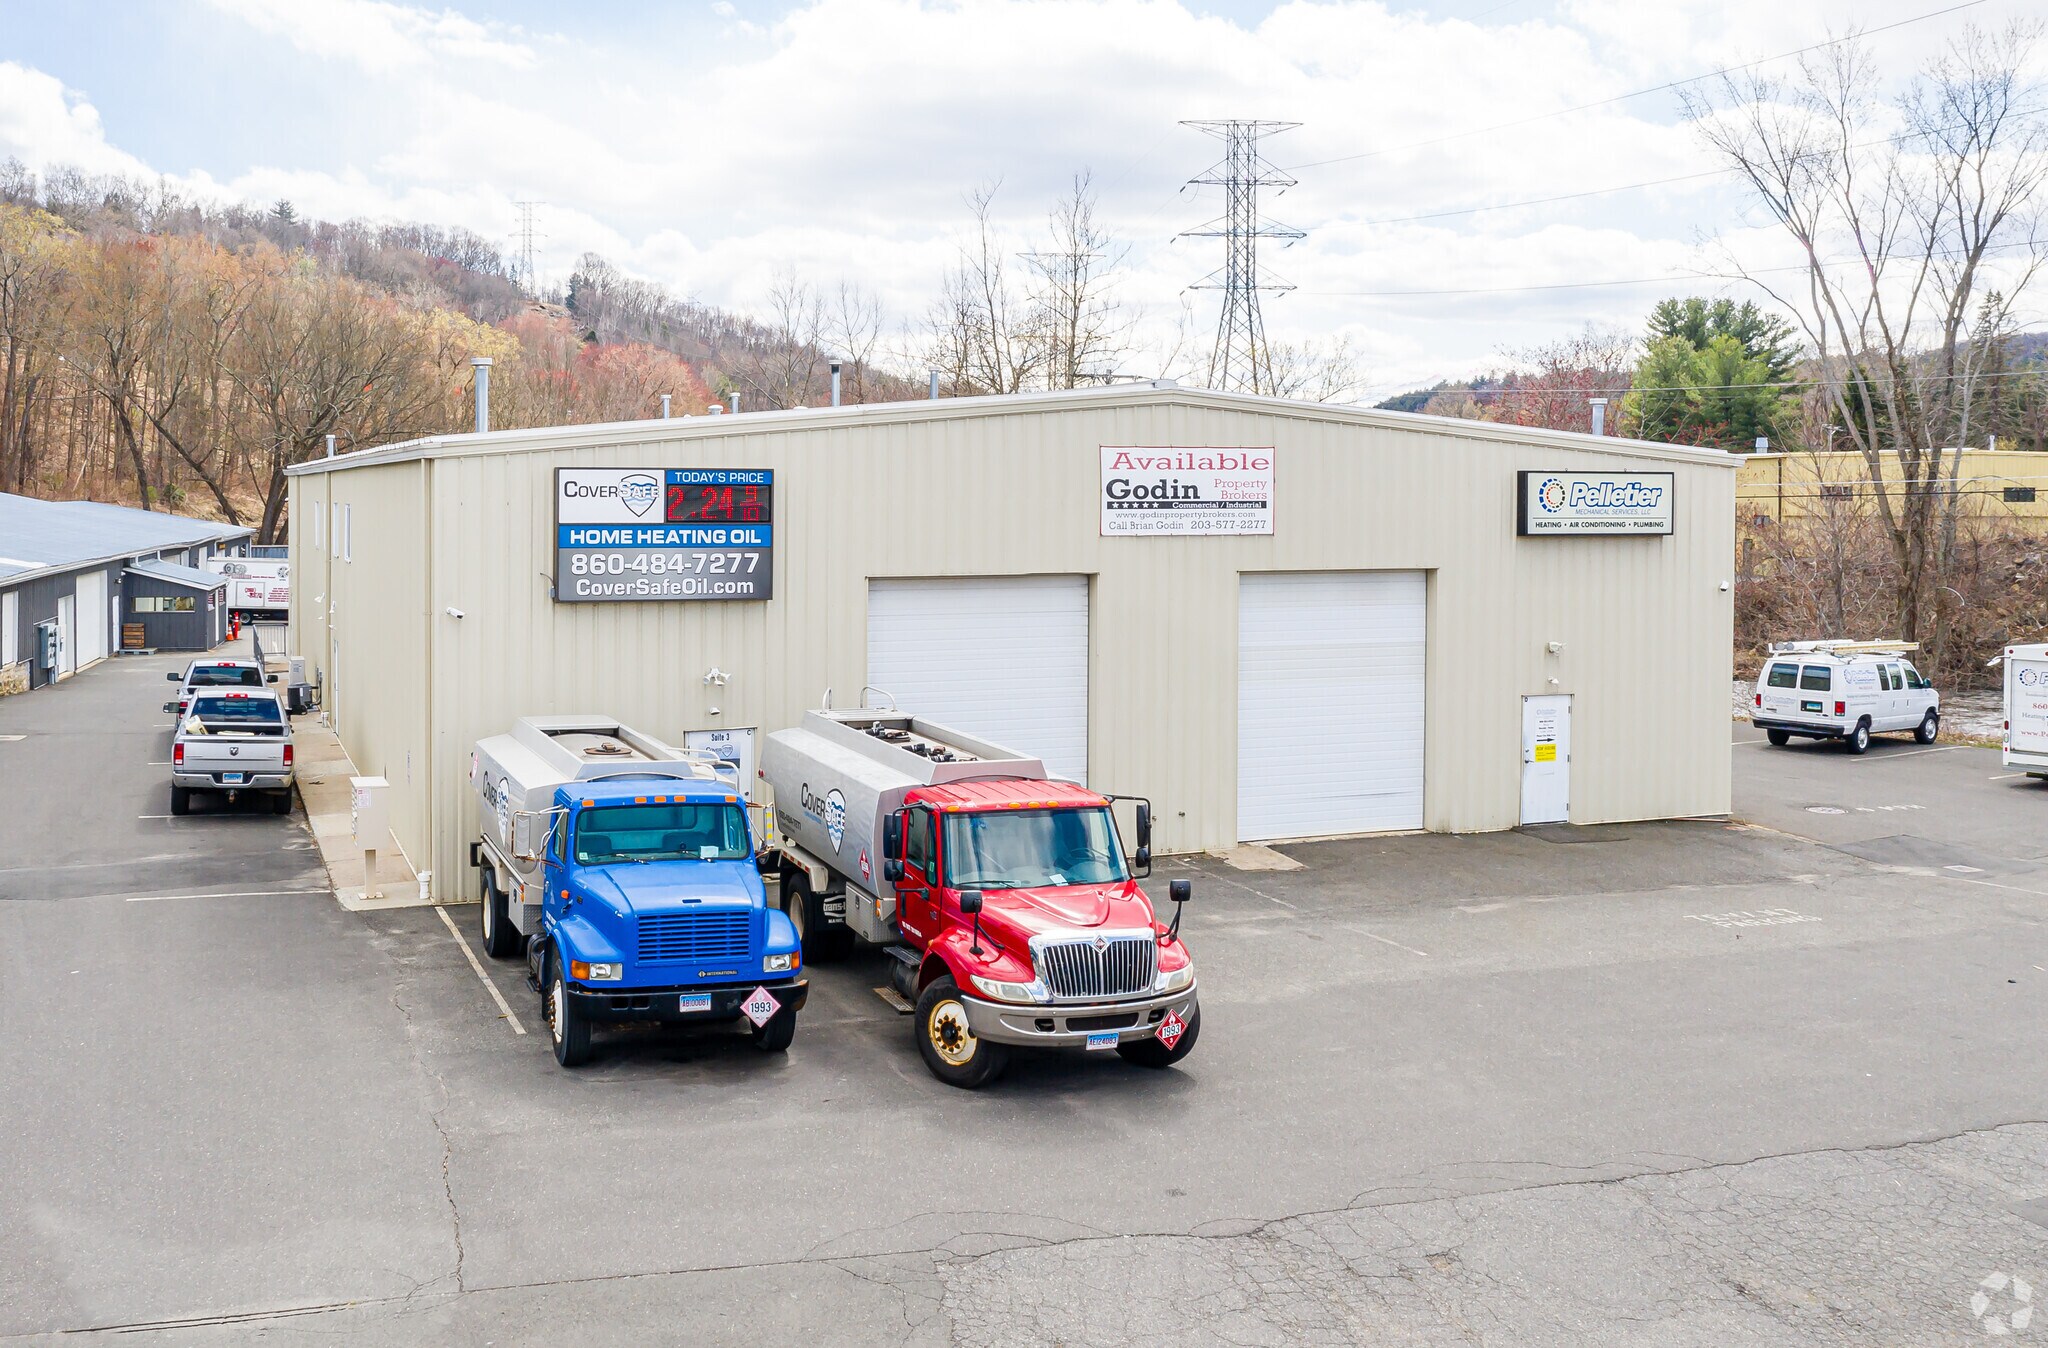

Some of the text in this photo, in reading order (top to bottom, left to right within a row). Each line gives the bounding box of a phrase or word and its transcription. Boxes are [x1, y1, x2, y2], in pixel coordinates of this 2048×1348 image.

[1109, 452, 1270, 471] Available
[675, 472, 764, 483] TODAY'S PRICE
[1105, 478, 1201, 500] Godin
[1214, 478, 1267, 490] Property
[1221, 490, 1267, 500] Brokers
[1569, 482, 1662, 507] Pelletier
[1172, 501, 1219, 509] Commercial
[1225, 501, 1262, 509] Industrial
[1115, 511, 1256, 520] www.godinpropertybrokers.com
[1108, 520, 1267, 530] Call Brian Godin 203-577-2277
[570, 529, 762, 545] HOME HEATING OIL
[571, 553, 760, 576] 860-484-7277
[576, 578, 754, 597] CoverSafeOil.com
[711, 733, 724, 741] Suite
[750, 1002, 771, 1013] 1993
[1163, 1024, 1180, 1037] 1993
